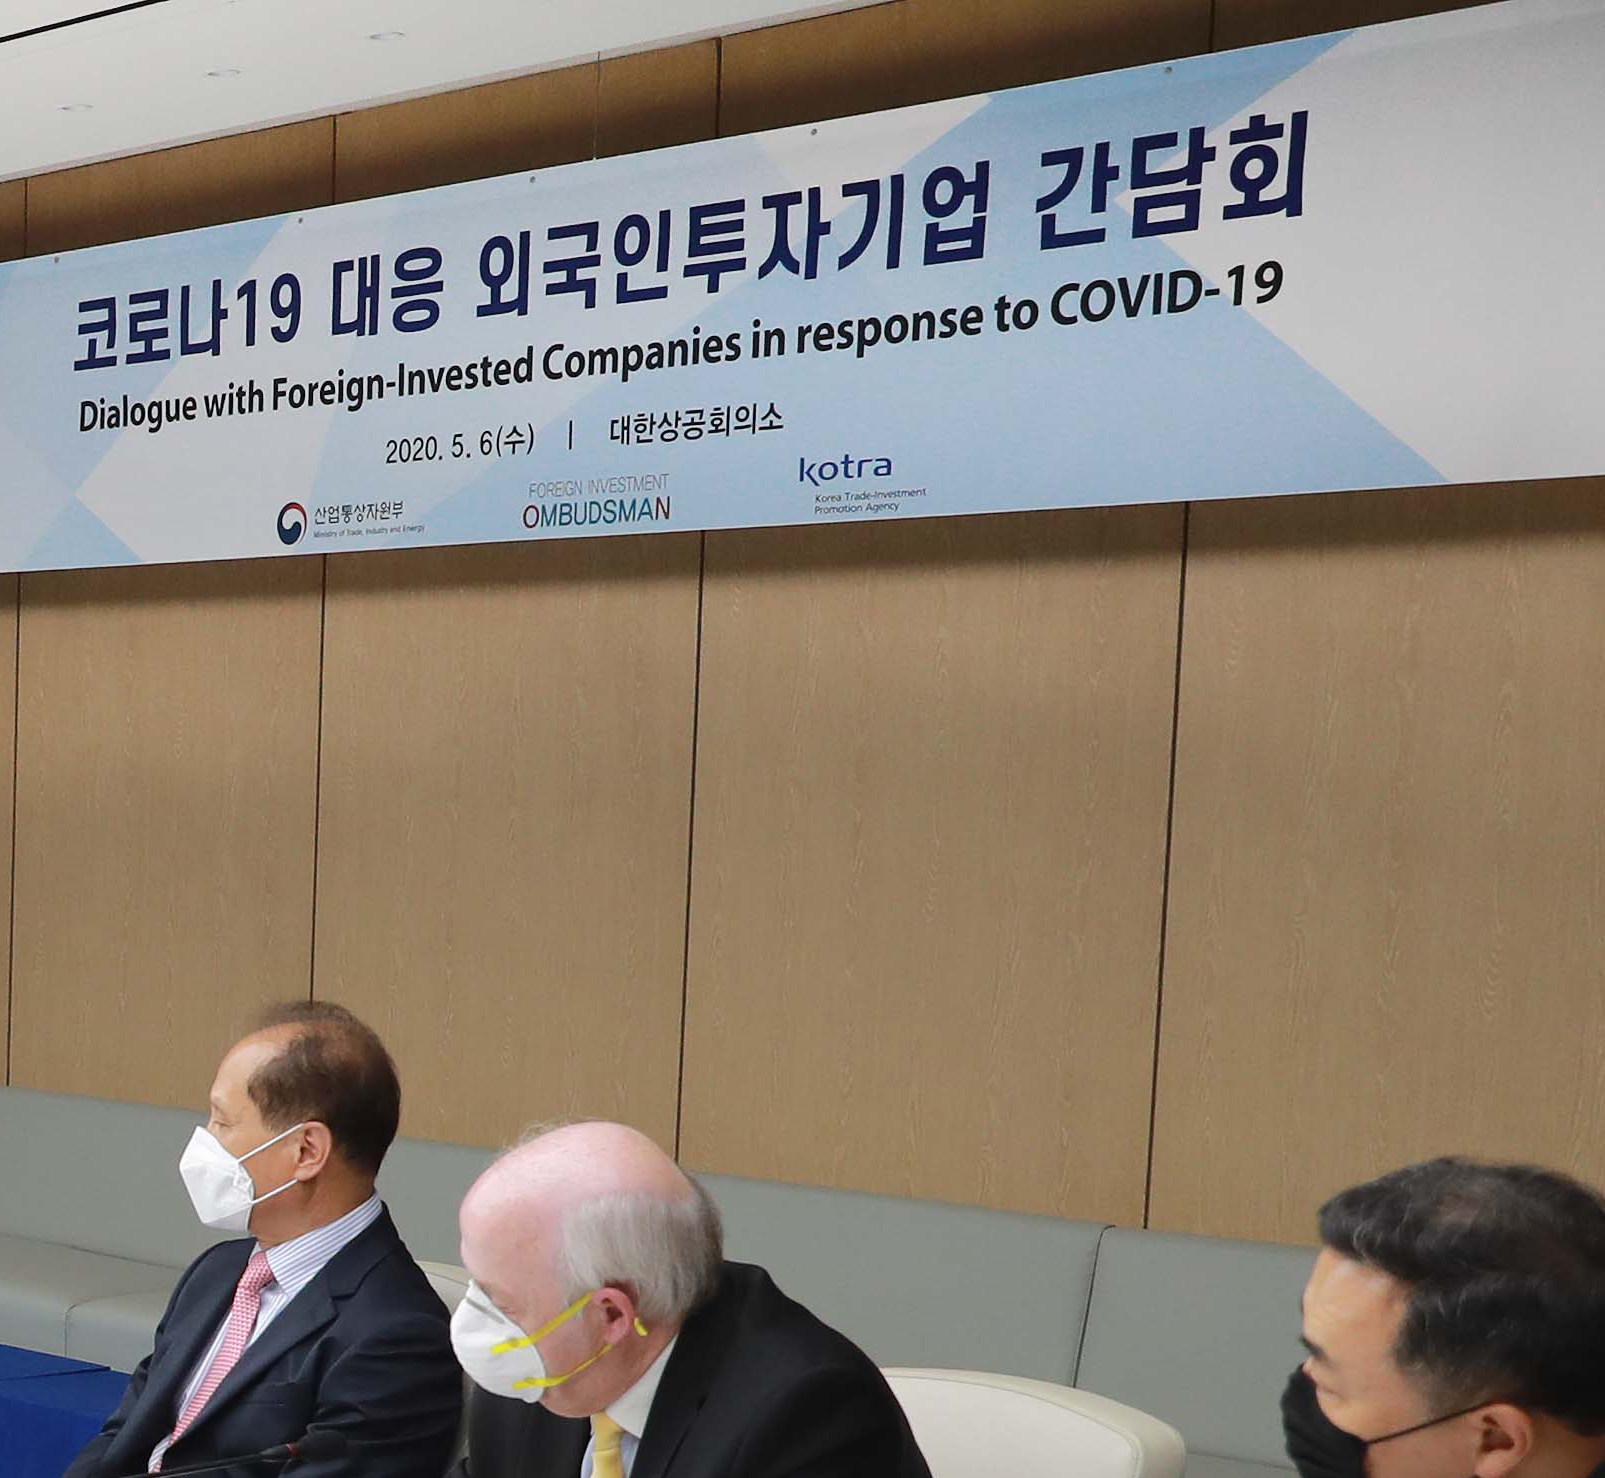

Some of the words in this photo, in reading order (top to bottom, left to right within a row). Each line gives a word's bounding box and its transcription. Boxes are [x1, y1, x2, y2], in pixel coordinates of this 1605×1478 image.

[74, 272, 301, 371] 코로나19
[330, 247, 445, 338] 대응
[476, 159, 990, 318] 외국인투자기업
[1035, 110, 1309, 251] 간담회
[79, 394, 197, 434] Dialogue
[204, 379, 265, 419] with
[272, 346, 534, 412] Foreign-Invested
[542, 325, 741, 383] Companies
[751, 318, 786, 359] in
[797, 303, 984, 359] response
[994, 295, 1039, 333] to
[1050, 260, 1284, 326] COVID-19
[386, 436, 444, 464] 2020.
[451, 433, 472, 458] 5.
[480, 423, 535, 459] 6(수)
[610, 402, 784, 446] 대한상공회의소
[528, 479, 583, 499] FOREIGN
[587, 473, 670, 495] INVESTMENT
[799, 454, 893, 487] kotra
[314, 500, 404, 525] 산업통상자원부
[523, 496, 671, 530] OMBUDSMAN
[815, 492, 842, 503] Korea
[865, 501, 901, 514] Agency
